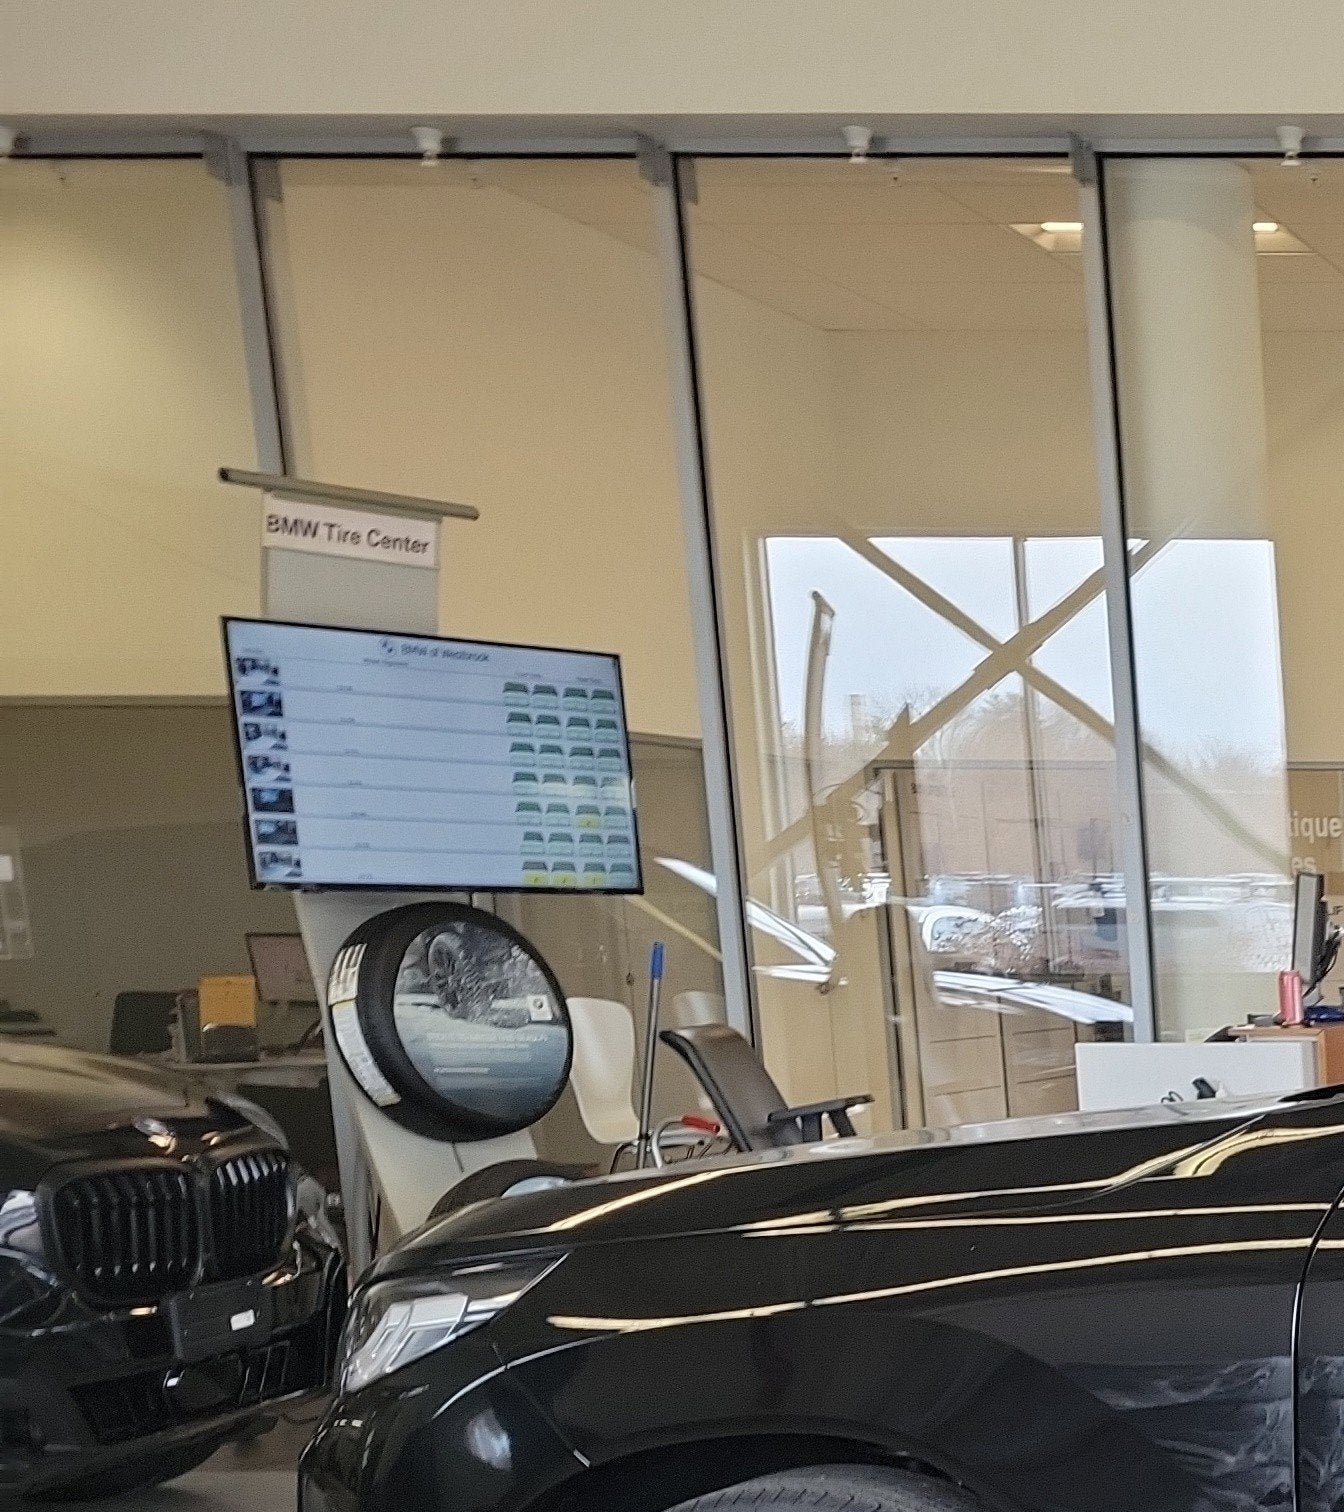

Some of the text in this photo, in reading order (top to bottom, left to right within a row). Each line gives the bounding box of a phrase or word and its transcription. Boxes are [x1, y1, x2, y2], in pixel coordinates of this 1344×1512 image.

[265, 513, 432, 556] BMW Tire Center
